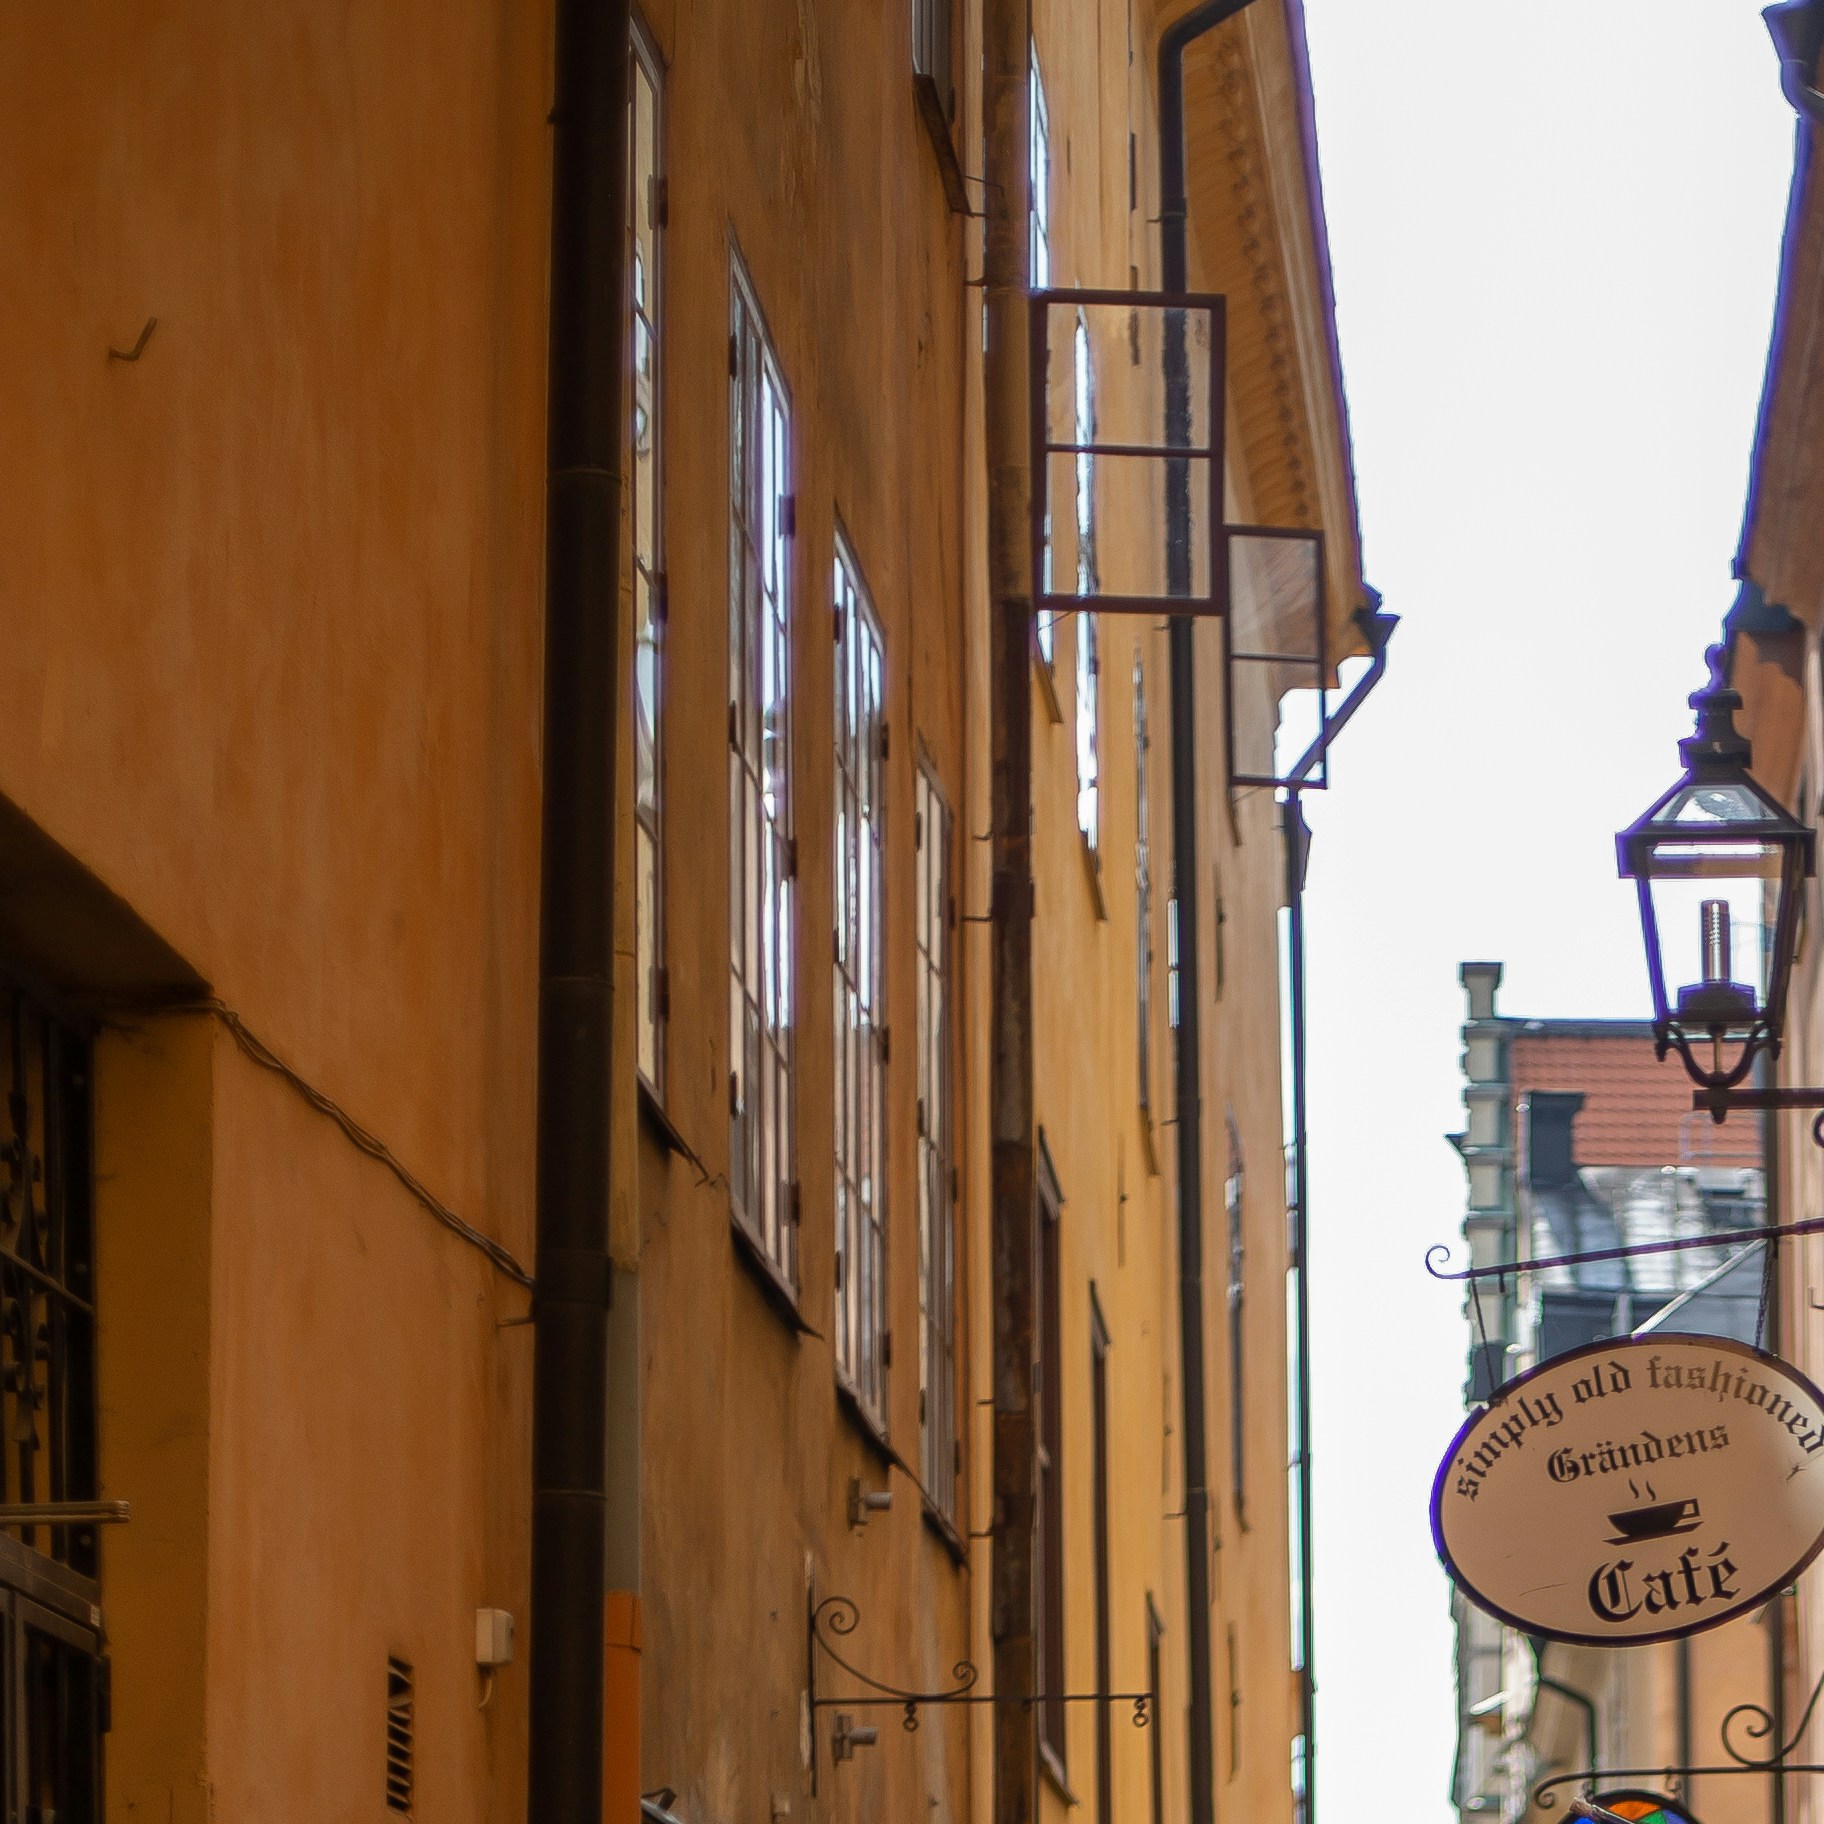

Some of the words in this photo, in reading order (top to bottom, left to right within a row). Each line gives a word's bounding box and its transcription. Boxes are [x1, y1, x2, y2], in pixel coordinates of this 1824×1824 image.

[1457, 1391, 1564, 1502] simply
[1572, 1360, 1632, 1405] old
[1547, 1424, 1731, 1483] Grändens
[1588, 1541, 1741, 1623] Café
